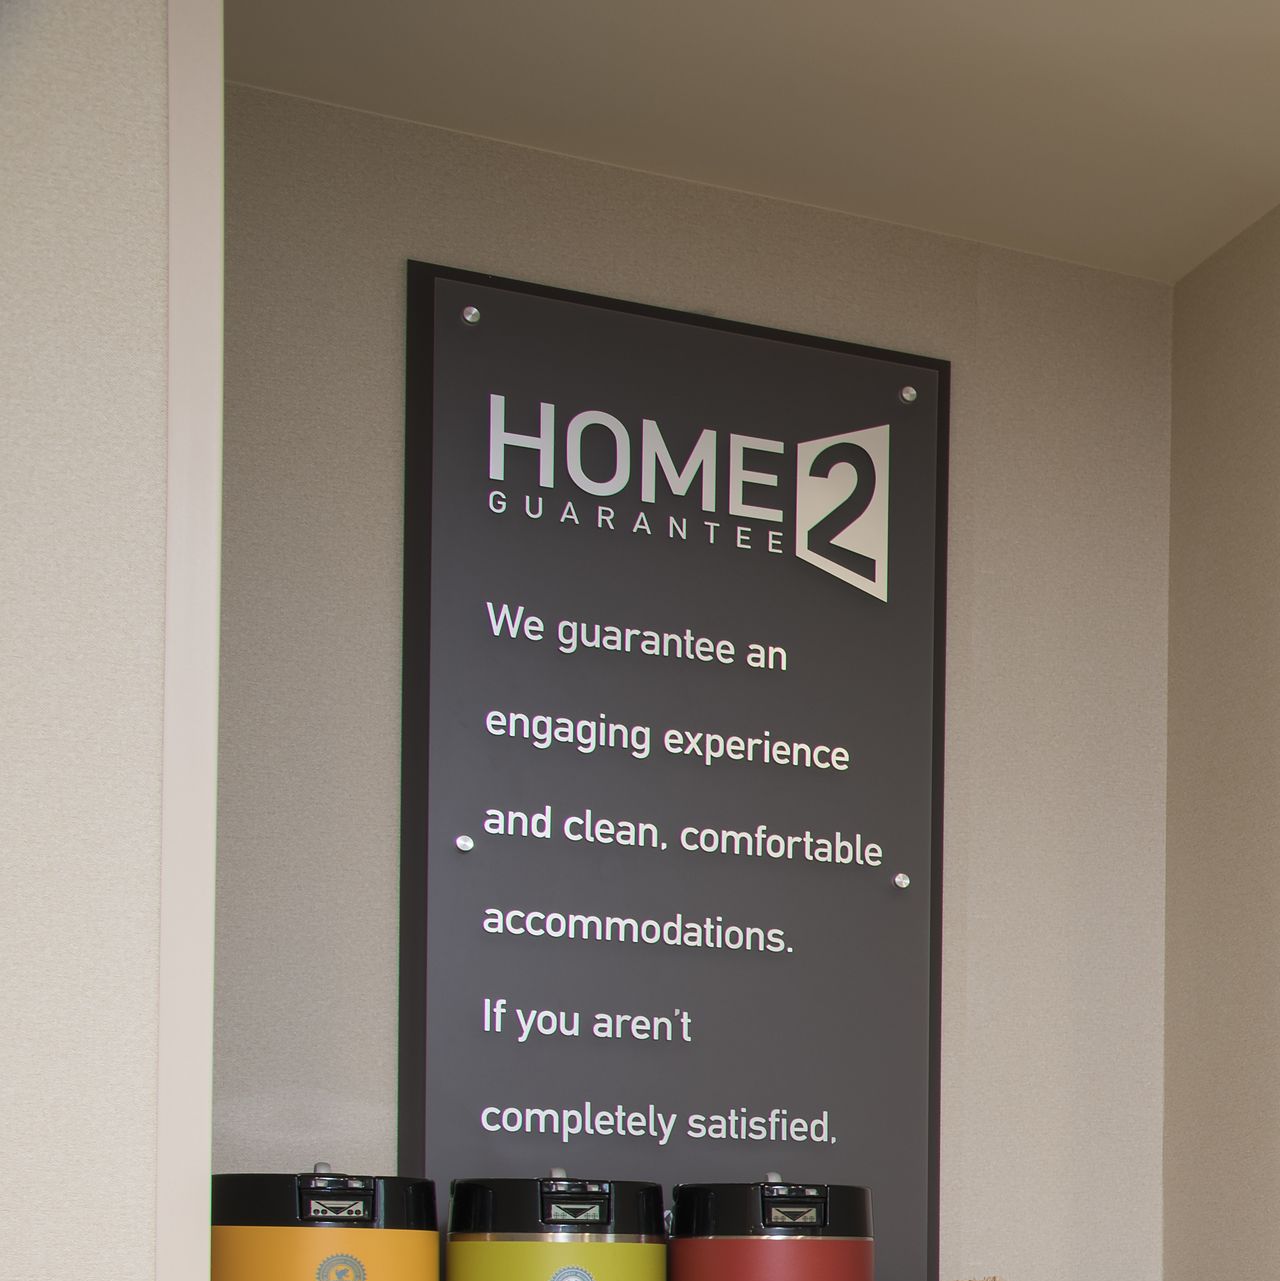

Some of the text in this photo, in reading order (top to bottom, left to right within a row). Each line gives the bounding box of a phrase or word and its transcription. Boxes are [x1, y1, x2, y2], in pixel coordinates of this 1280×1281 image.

[488, 490, 784, 554] GUARANTEE
[486, 601, 788, 671] We guarantee an
[485, 710, 850, 771] engaging experience
[483, 806, 883, 867] and clean, comfortable
[482, 907, 794, 953] accommodations.
[482, 998, 692, 1042] If you aren't
[481, 1101, 837, 1145] completely satisfied,
